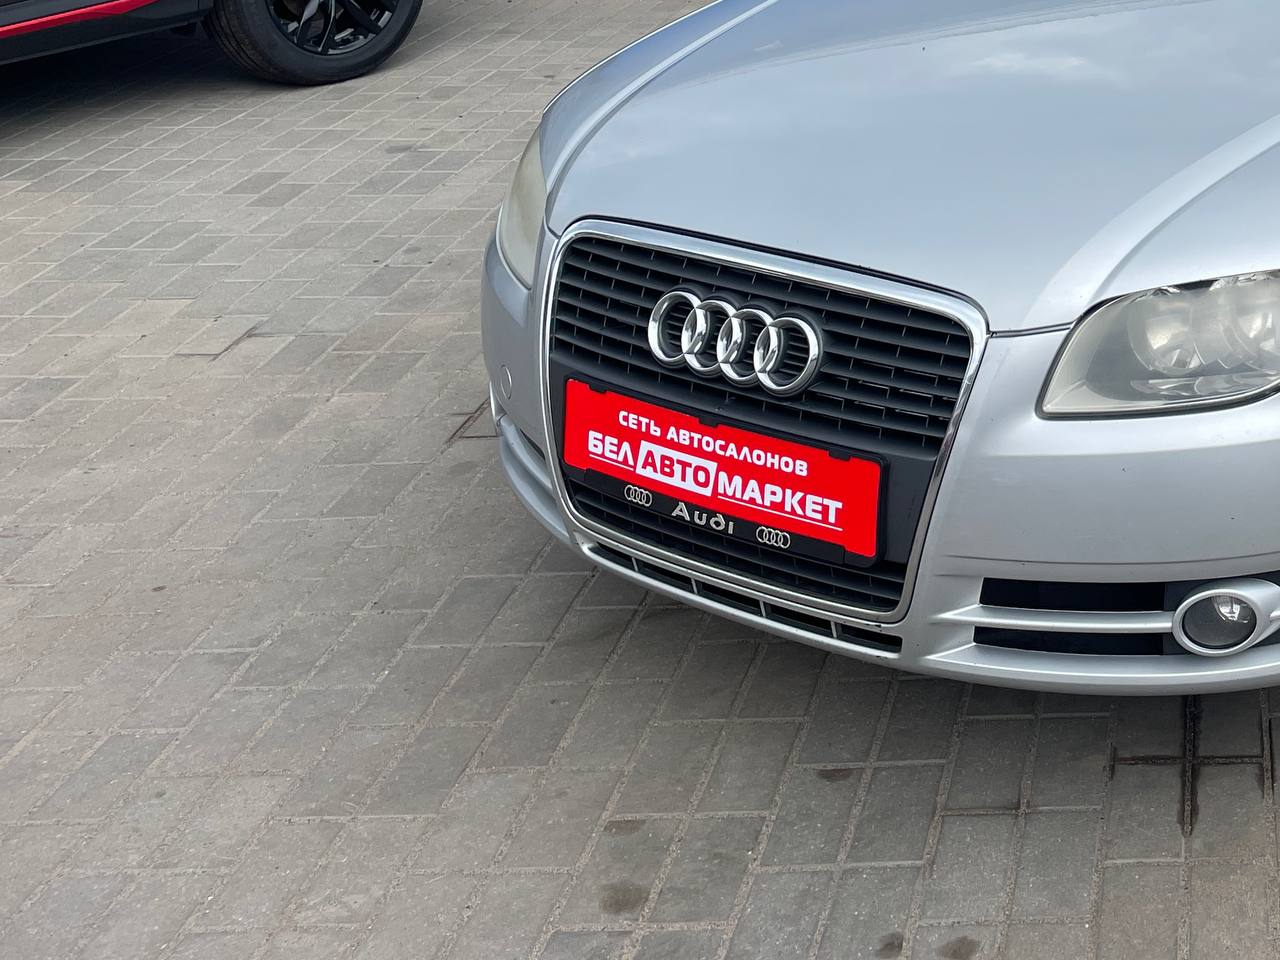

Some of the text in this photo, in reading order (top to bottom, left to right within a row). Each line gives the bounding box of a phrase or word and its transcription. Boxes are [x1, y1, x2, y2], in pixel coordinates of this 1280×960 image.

[618, 410, 809, 477] СЕТЬ АВТОСАЛОНОВ
[588, 430, 843, 525] БЕЛ АВТО МАРКЕТ
[671, 501, 735, 535] Audi
